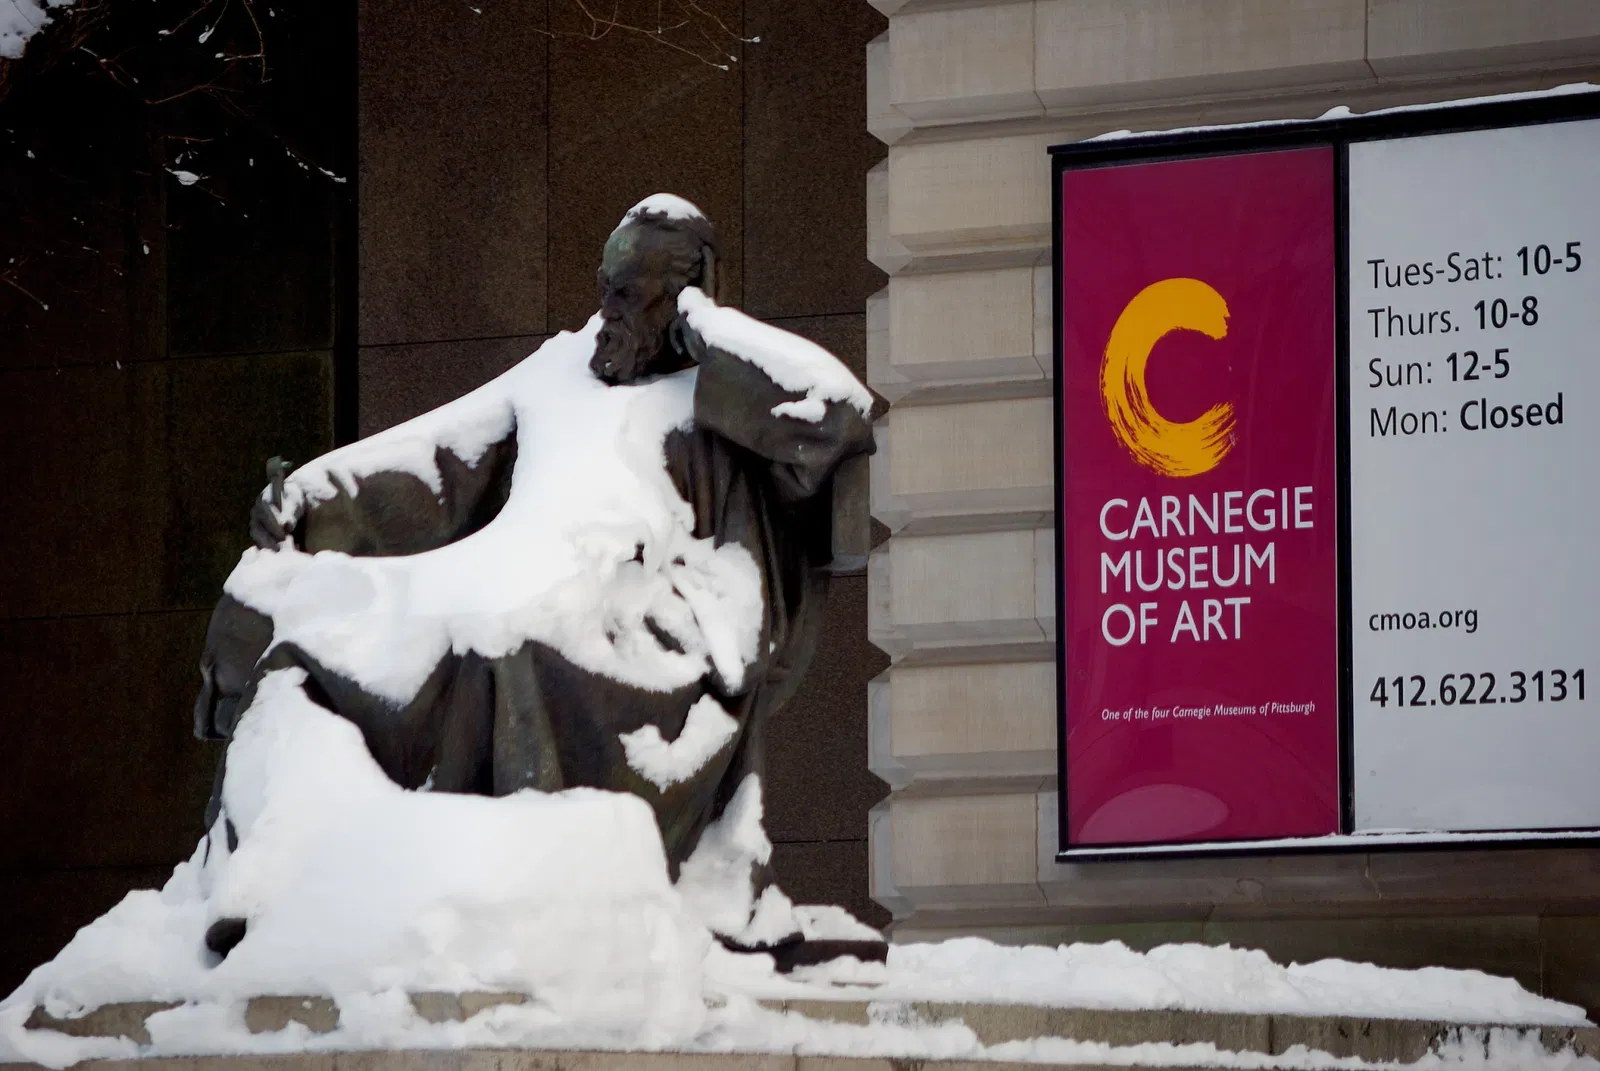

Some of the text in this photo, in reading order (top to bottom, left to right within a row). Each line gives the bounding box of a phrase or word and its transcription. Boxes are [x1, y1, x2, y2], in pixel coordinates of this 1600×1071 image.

[1367, 241, 1582, 289] Tues-Sat: 10-5
[1367, 295, 1539, 338] Thurs. 10-8
[1368, 348, 1510, 388] Sun: 12-5
[1370, 392, 1564, 437] Mon: Closed
[1099, 486, 1314, 541] CARNEGIE
[1101, 542, 1276, 593] MUSEUM
[1101, 597, 1251, 646] OF ART
[1369, 609, 1478, 633] cmoa.org
[1370, 668, 1585, 708] 412.622.3131
[1101, 700, 1316, 722] One of the four Carnegie Museums of Pittsburgh
